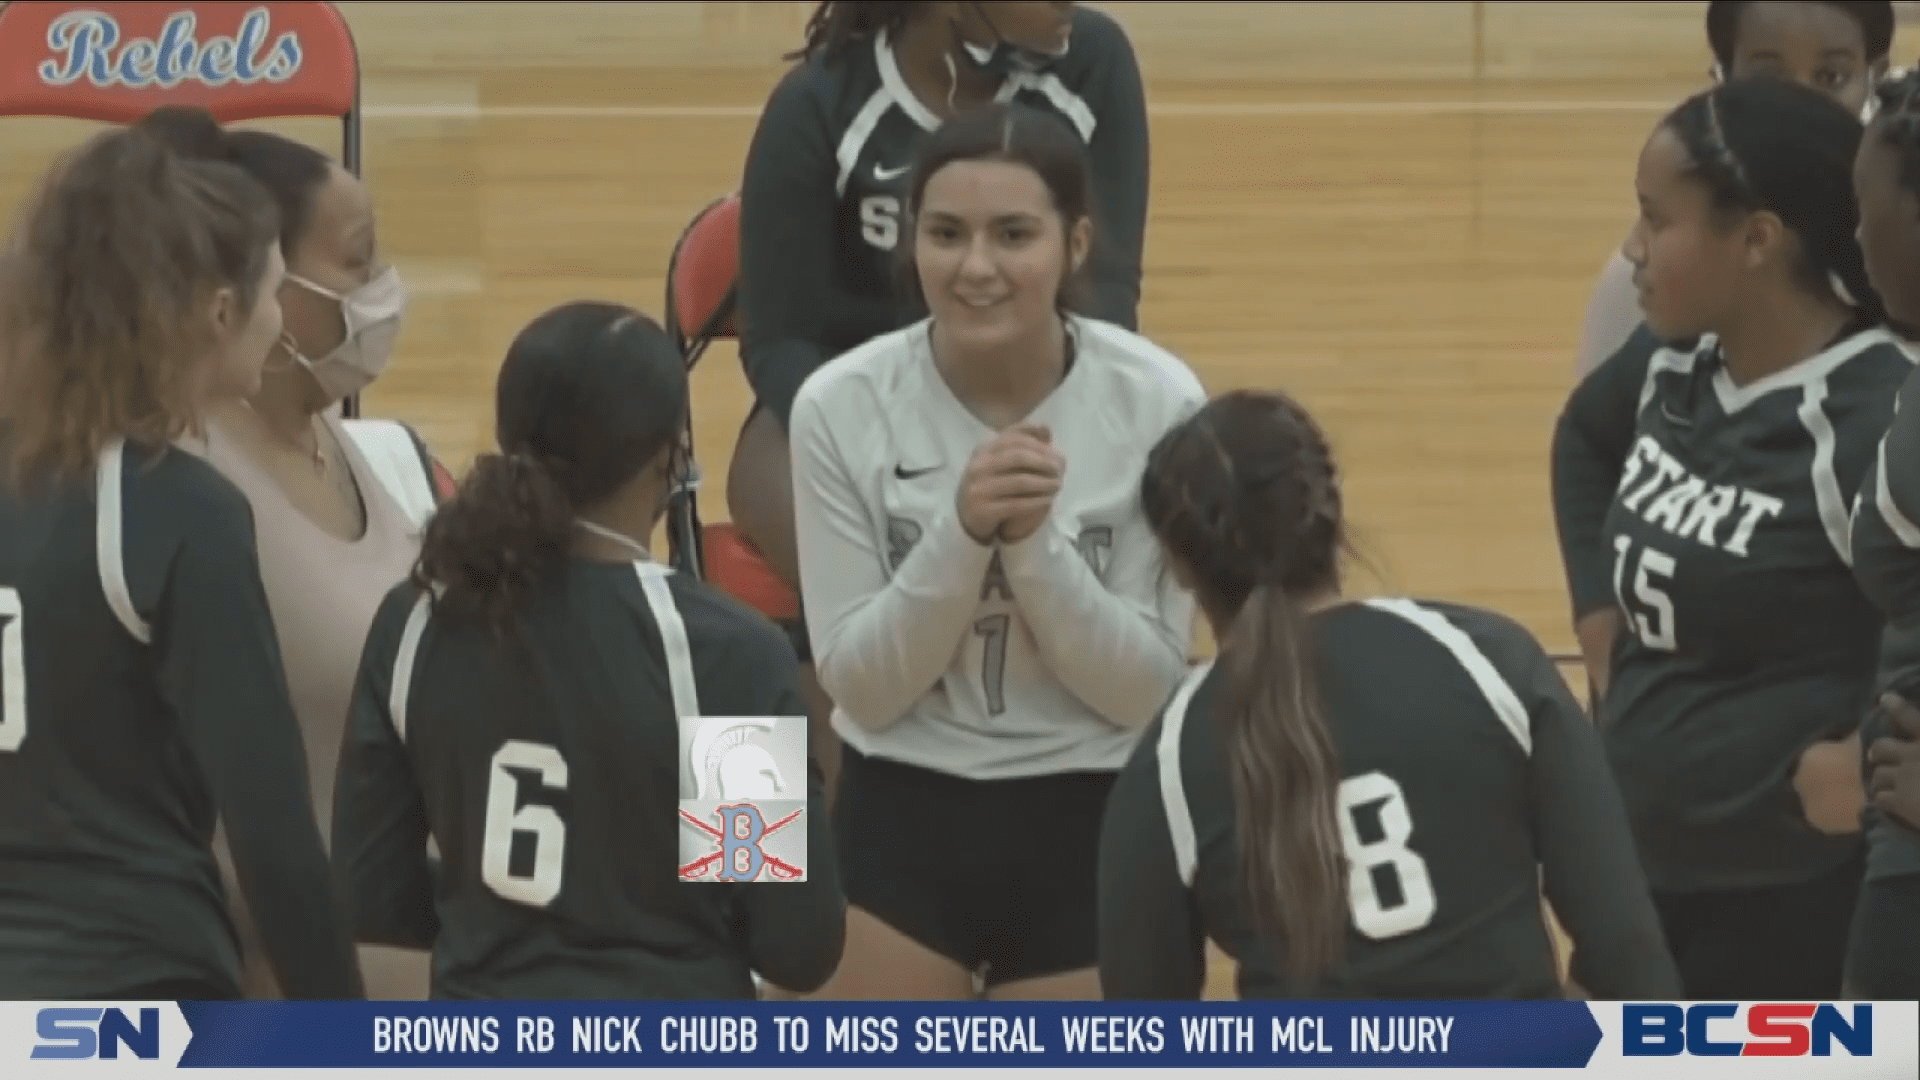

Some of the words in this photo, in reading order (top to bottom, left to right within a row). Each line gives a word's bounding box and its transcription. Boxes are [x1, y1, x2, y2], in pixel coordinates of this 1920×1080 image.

[38, 7, 303, 90] Rebels
[1617, 434, 1785, 558] START
[1613, 534, 1678, 650] 15
[481, 739, 569, 908] 6
[1335, 770, 1438, 941] 8
